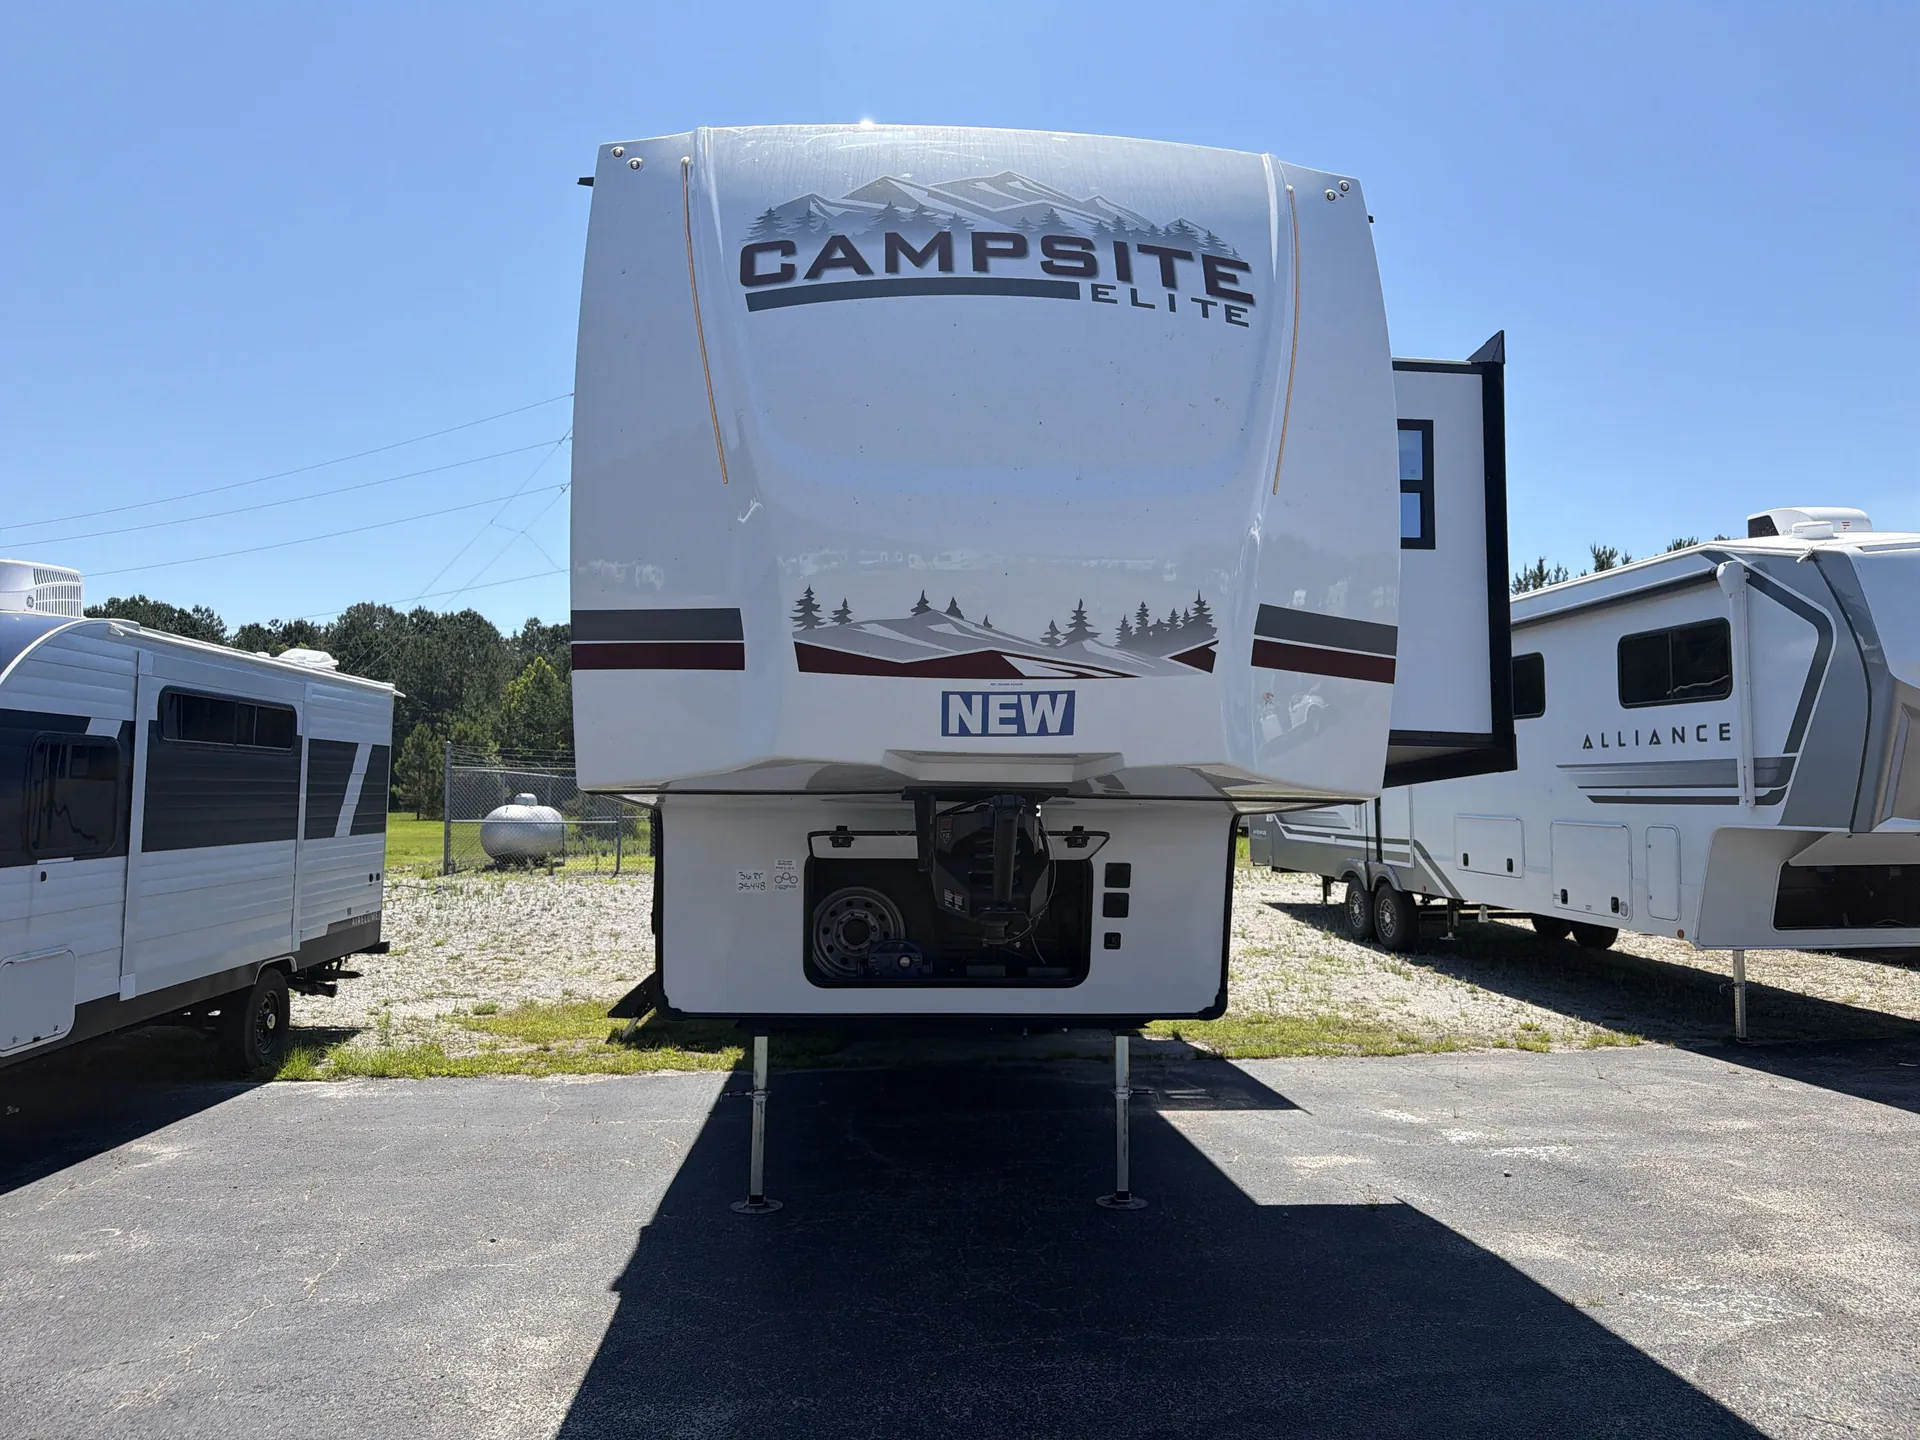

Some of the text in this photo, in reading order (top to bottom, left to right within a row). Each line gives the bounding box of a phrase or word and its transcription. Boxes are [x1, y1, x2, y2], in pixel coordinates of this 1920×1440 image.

[739, 231, 1255, 306] CAMPSITE
[1089, 283, 1250, 328] ELITE
[948, 693, 1069, 734] NEW
[1582, 722, 1731, 750] ALLIANCE
